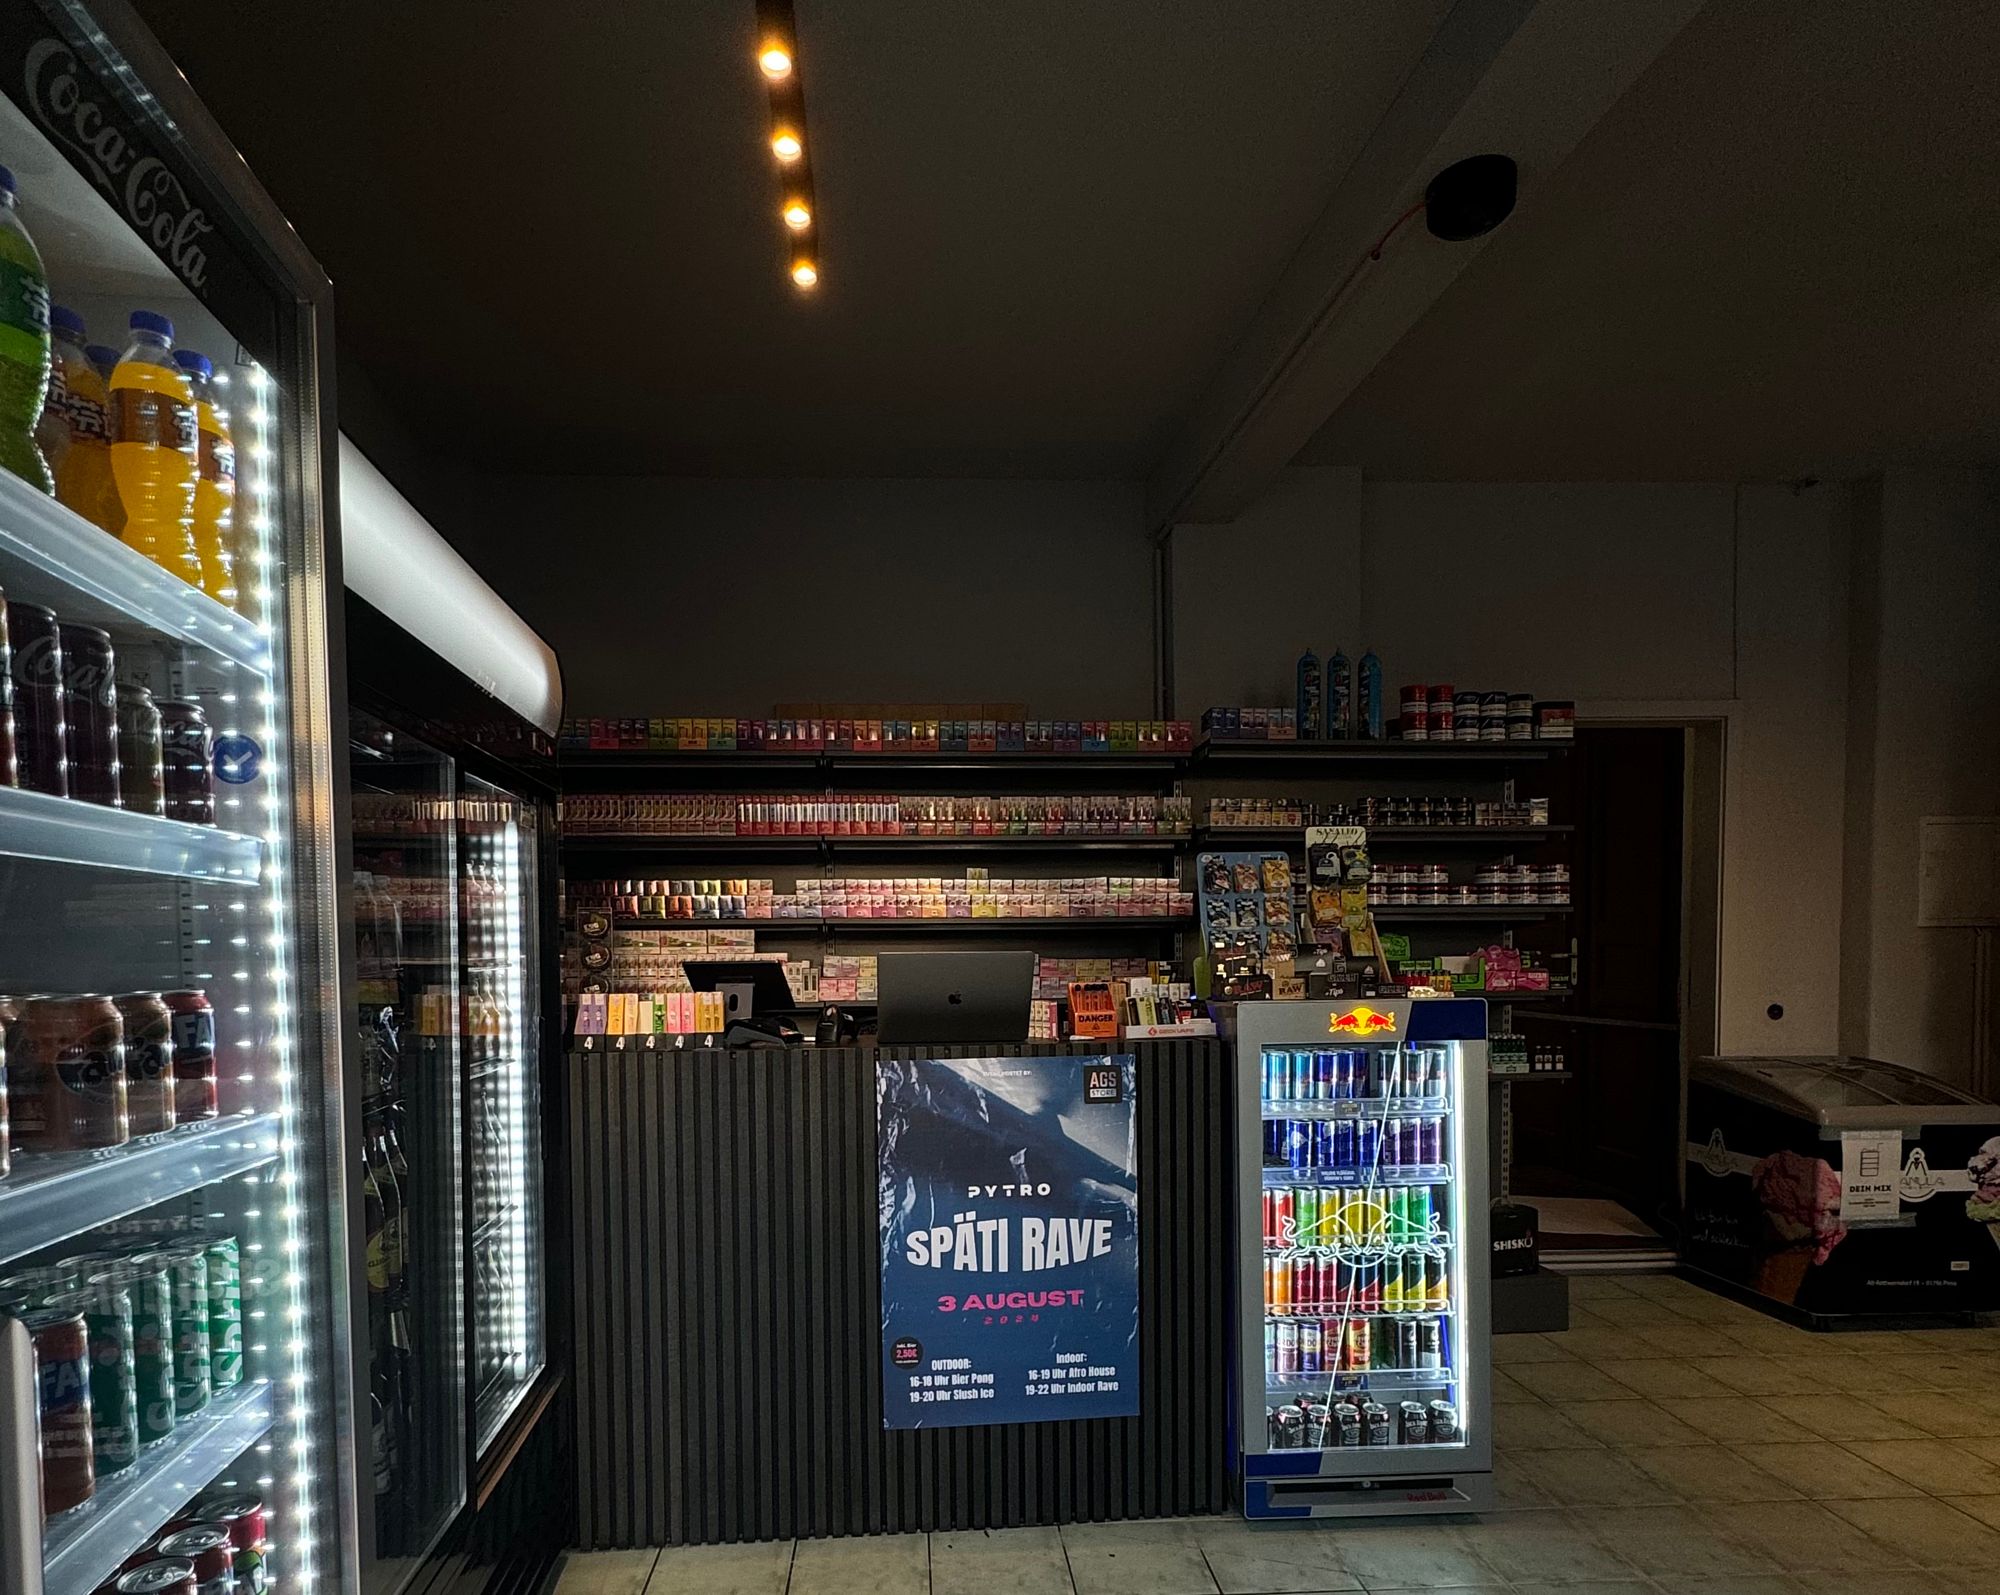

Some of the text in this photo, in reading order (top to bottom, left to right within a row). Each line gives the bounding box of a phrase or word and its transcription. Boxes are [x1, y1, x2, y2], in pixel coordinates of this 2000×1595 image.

[24, 38, 216, 290] Coca-Cola
[1279, 985, 1302, 995] RAW
[1078, 1014, 1113, 1023] DANGER
[583, 1036, 594, 1049] 4
[615, 1036, 625, 1049] 4
[645, 1035, 656, 1049] 4
[675, 1035, 685, 1048] 4
[704, 1034, 714, 1048] 4
[1089, 1071, 1117, 1088] AGS
[1090, 1089, 1116, 1097] STORE
[968, 1183, 1051, 1198] PYTRO
[1849, 1184, 1892, 1193] DEIN MIX
[906, 1211, 1113, 1273] SPÄTI RAVE
[937, 1289, 1085, 1312] 3 AUGUST
[931, 1358, 972, 1371] OUTDOOR:
[1056, 1353, 1088, 1364] Indoor:
[909, 1372, 994, 1387] 16-18 Uhr Bier Pong
[1028, 1366, 1116, 1381] 16-19 Uhr Afro House
[909, 1388, 995, 1403] 19-20 Uhr Slush Ice
[1025, 1381, 1119, 1396] 19-22 Uhr Indoor Rave
